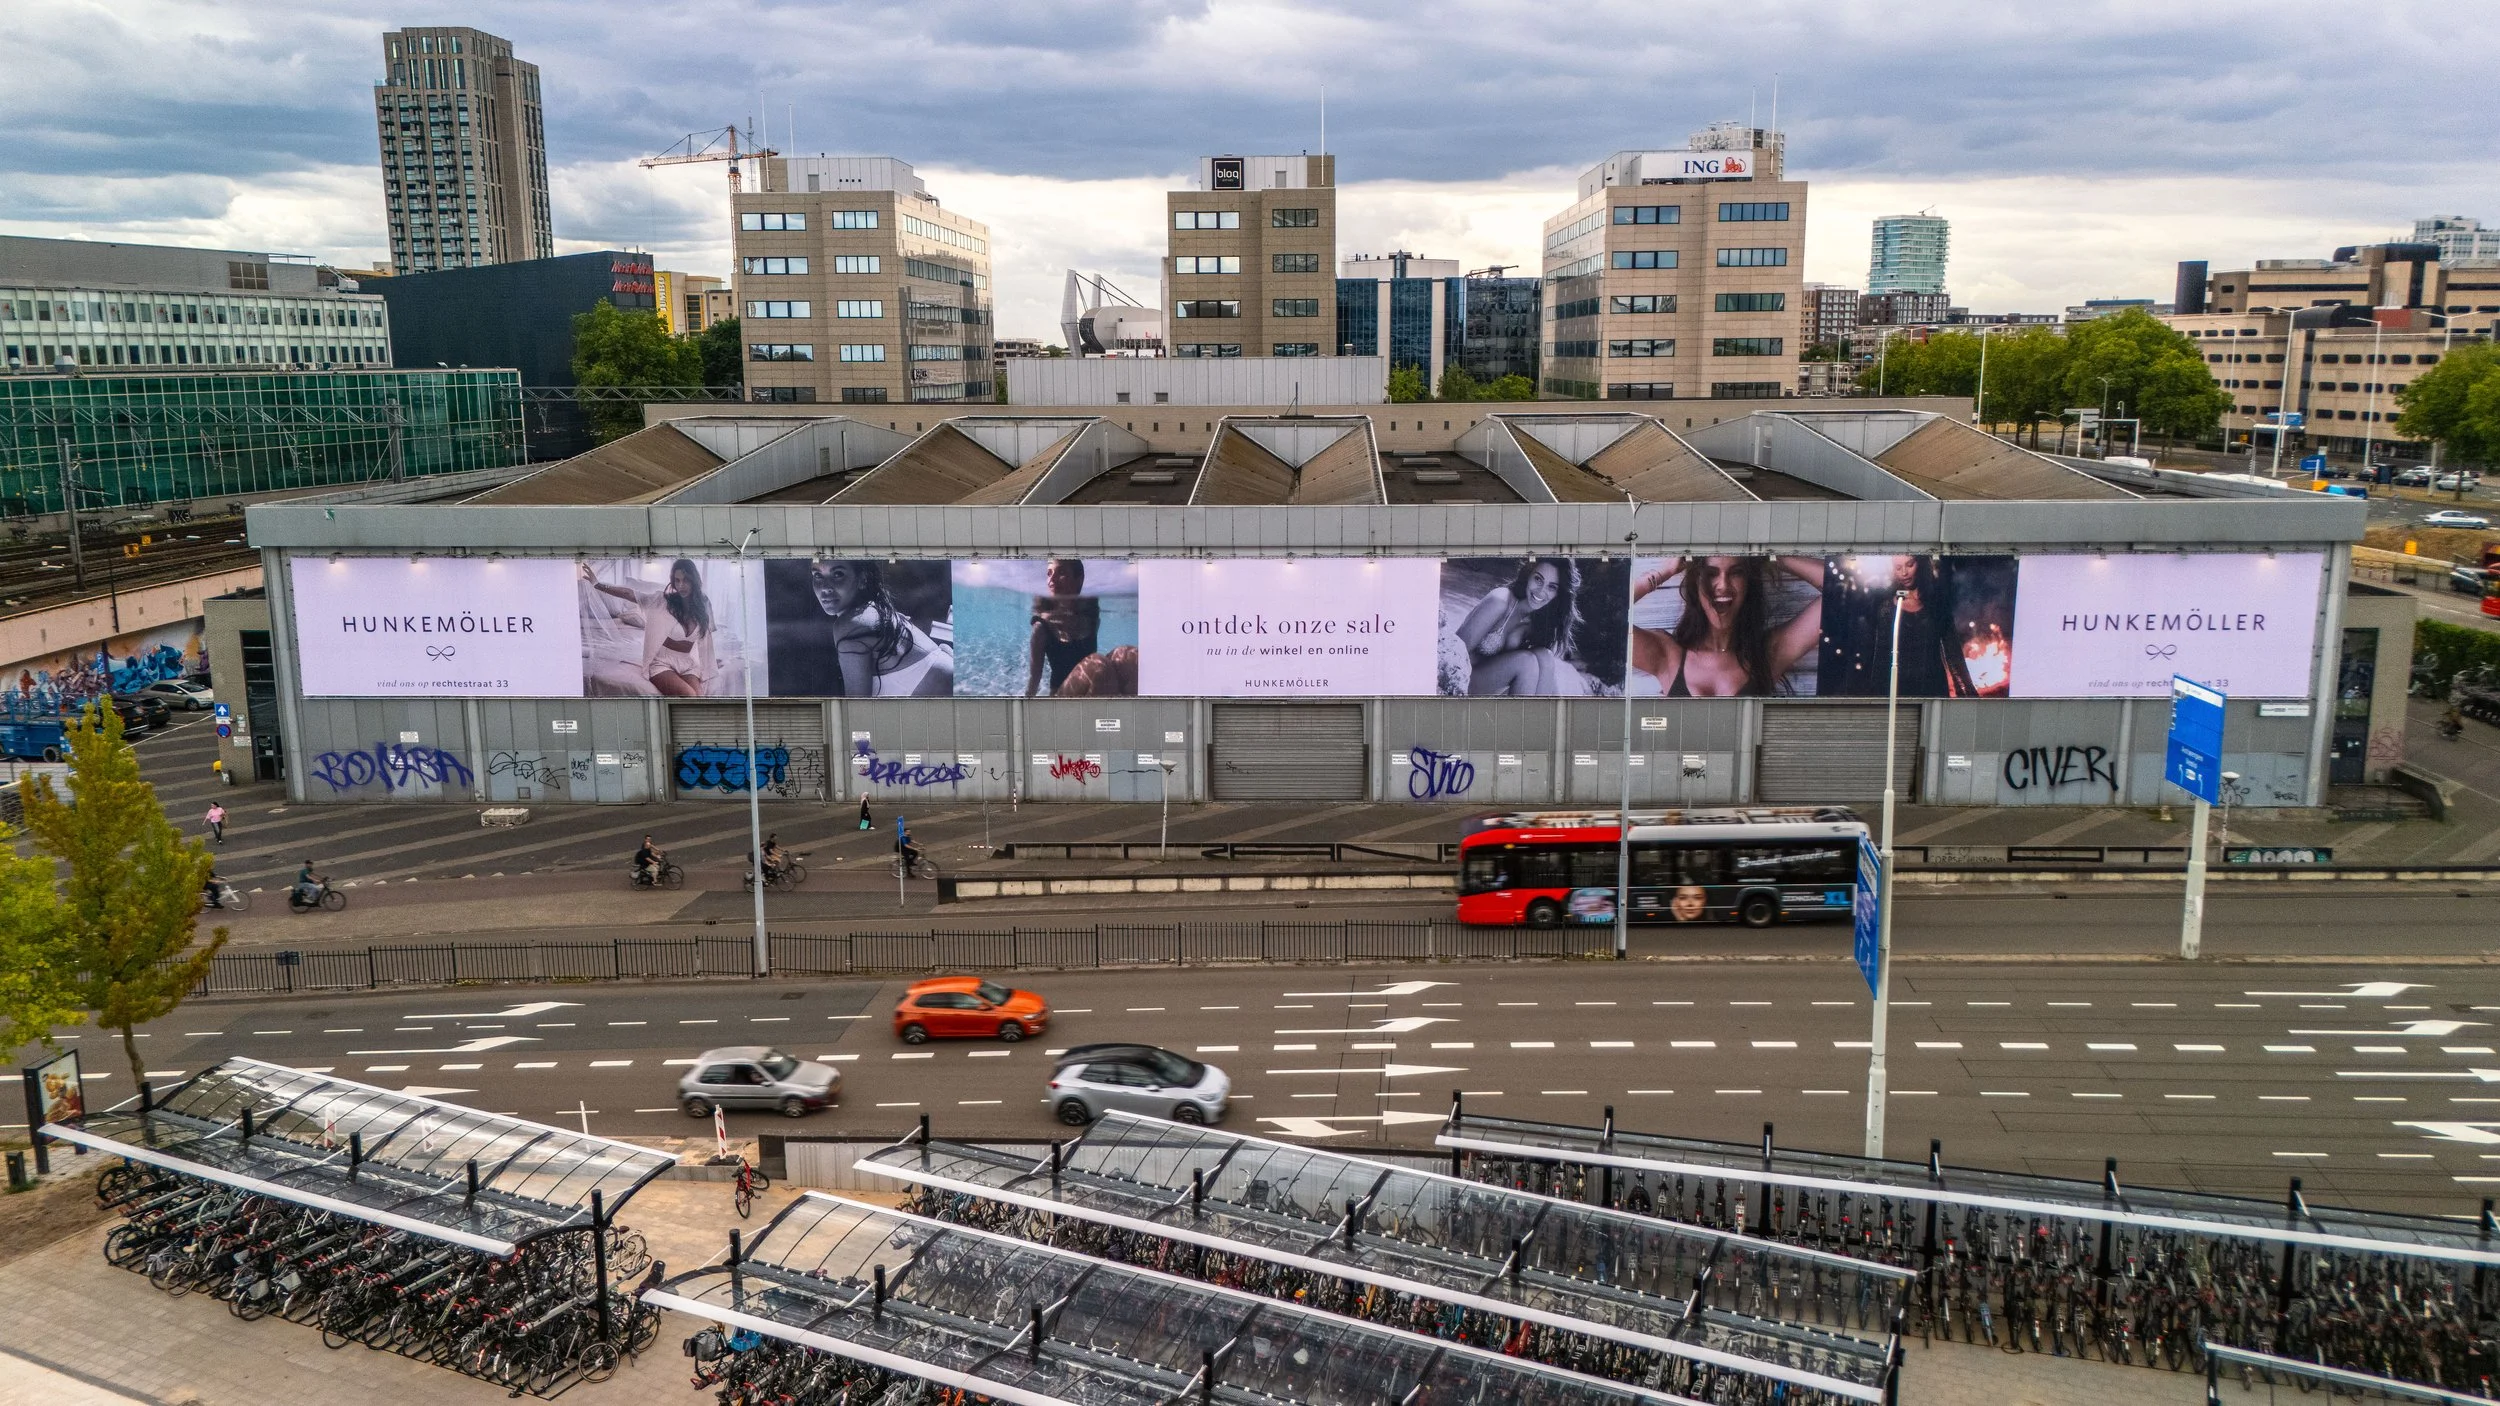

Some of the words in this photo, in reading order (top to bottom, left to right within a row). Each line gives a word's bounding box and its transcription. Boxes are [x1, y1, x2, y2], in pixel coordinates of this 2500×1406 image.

[1683, 160, 1719, 174] ING
[1217, 168, 1239, 180] bloq
[343, 610, 534, 634] HUNKEMÖLLER
[1181, 614, 1268, 634] ontdek
[1278, 620, 1337, 634] onze
[1346, 613, 1396, 634] sale
[2062, 608, 2265, 632] HUNKEMÖLLER
[1206, 648, 1222, 656] nu
[1226, 645, 1238, 656] in
[1241, 645, 1256, 656] de
[1260, 645, 1303, 656] winkel
[1308, 647, 1323, 655] en
[1328, 645, 1369, 655] online
[377, 680, 398, 688] vind
[418, 682, 430, 690] op
[431, 679, 493, 688] rechtestraat
[496, 679, 509, 688] 33
[1245, 677, 1330, 688] HUNKEMÖLLER
[2215, 678, 2229, 688] 33
